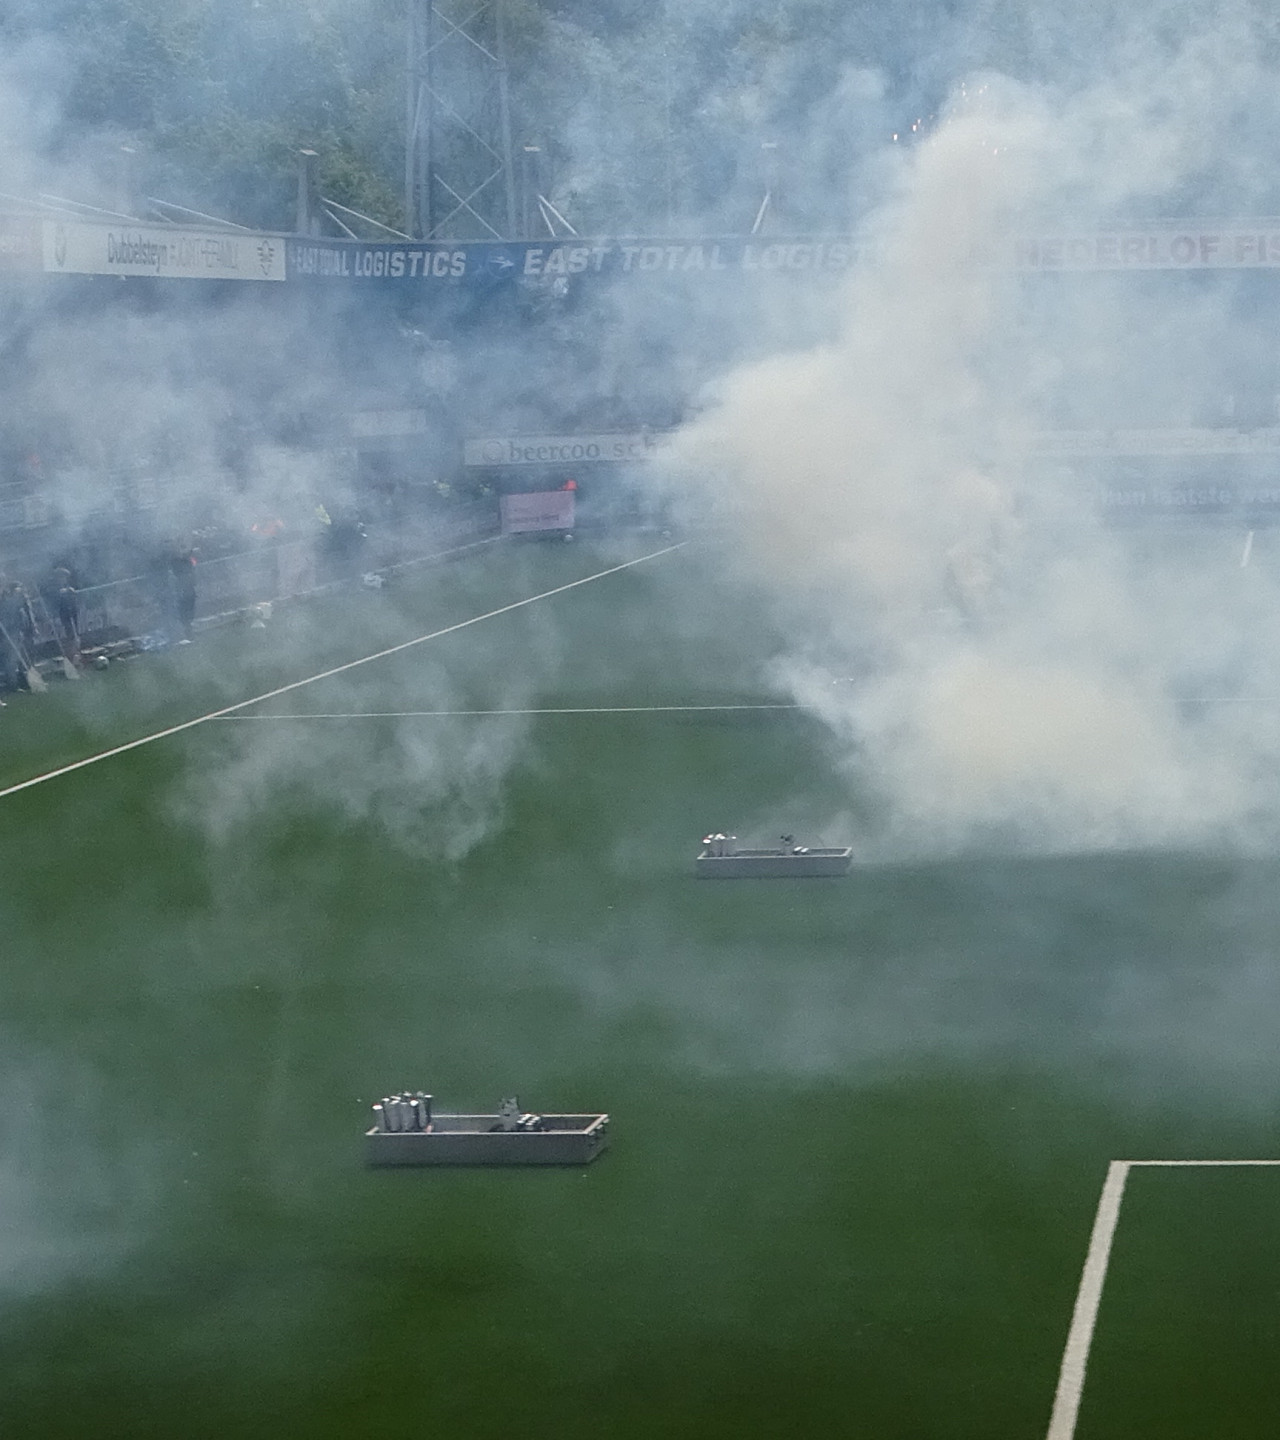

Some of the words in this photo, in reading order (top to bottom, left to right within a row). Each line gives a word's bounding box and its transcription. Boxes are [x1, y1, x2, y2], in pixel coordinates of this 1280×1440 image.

[355, 250, 467, 277] LOGISTICS
[523, 246, 611, 274] EAST
[621, 244, 727, 272] TOTAL
[508, 440, 600, 462] beercoo
